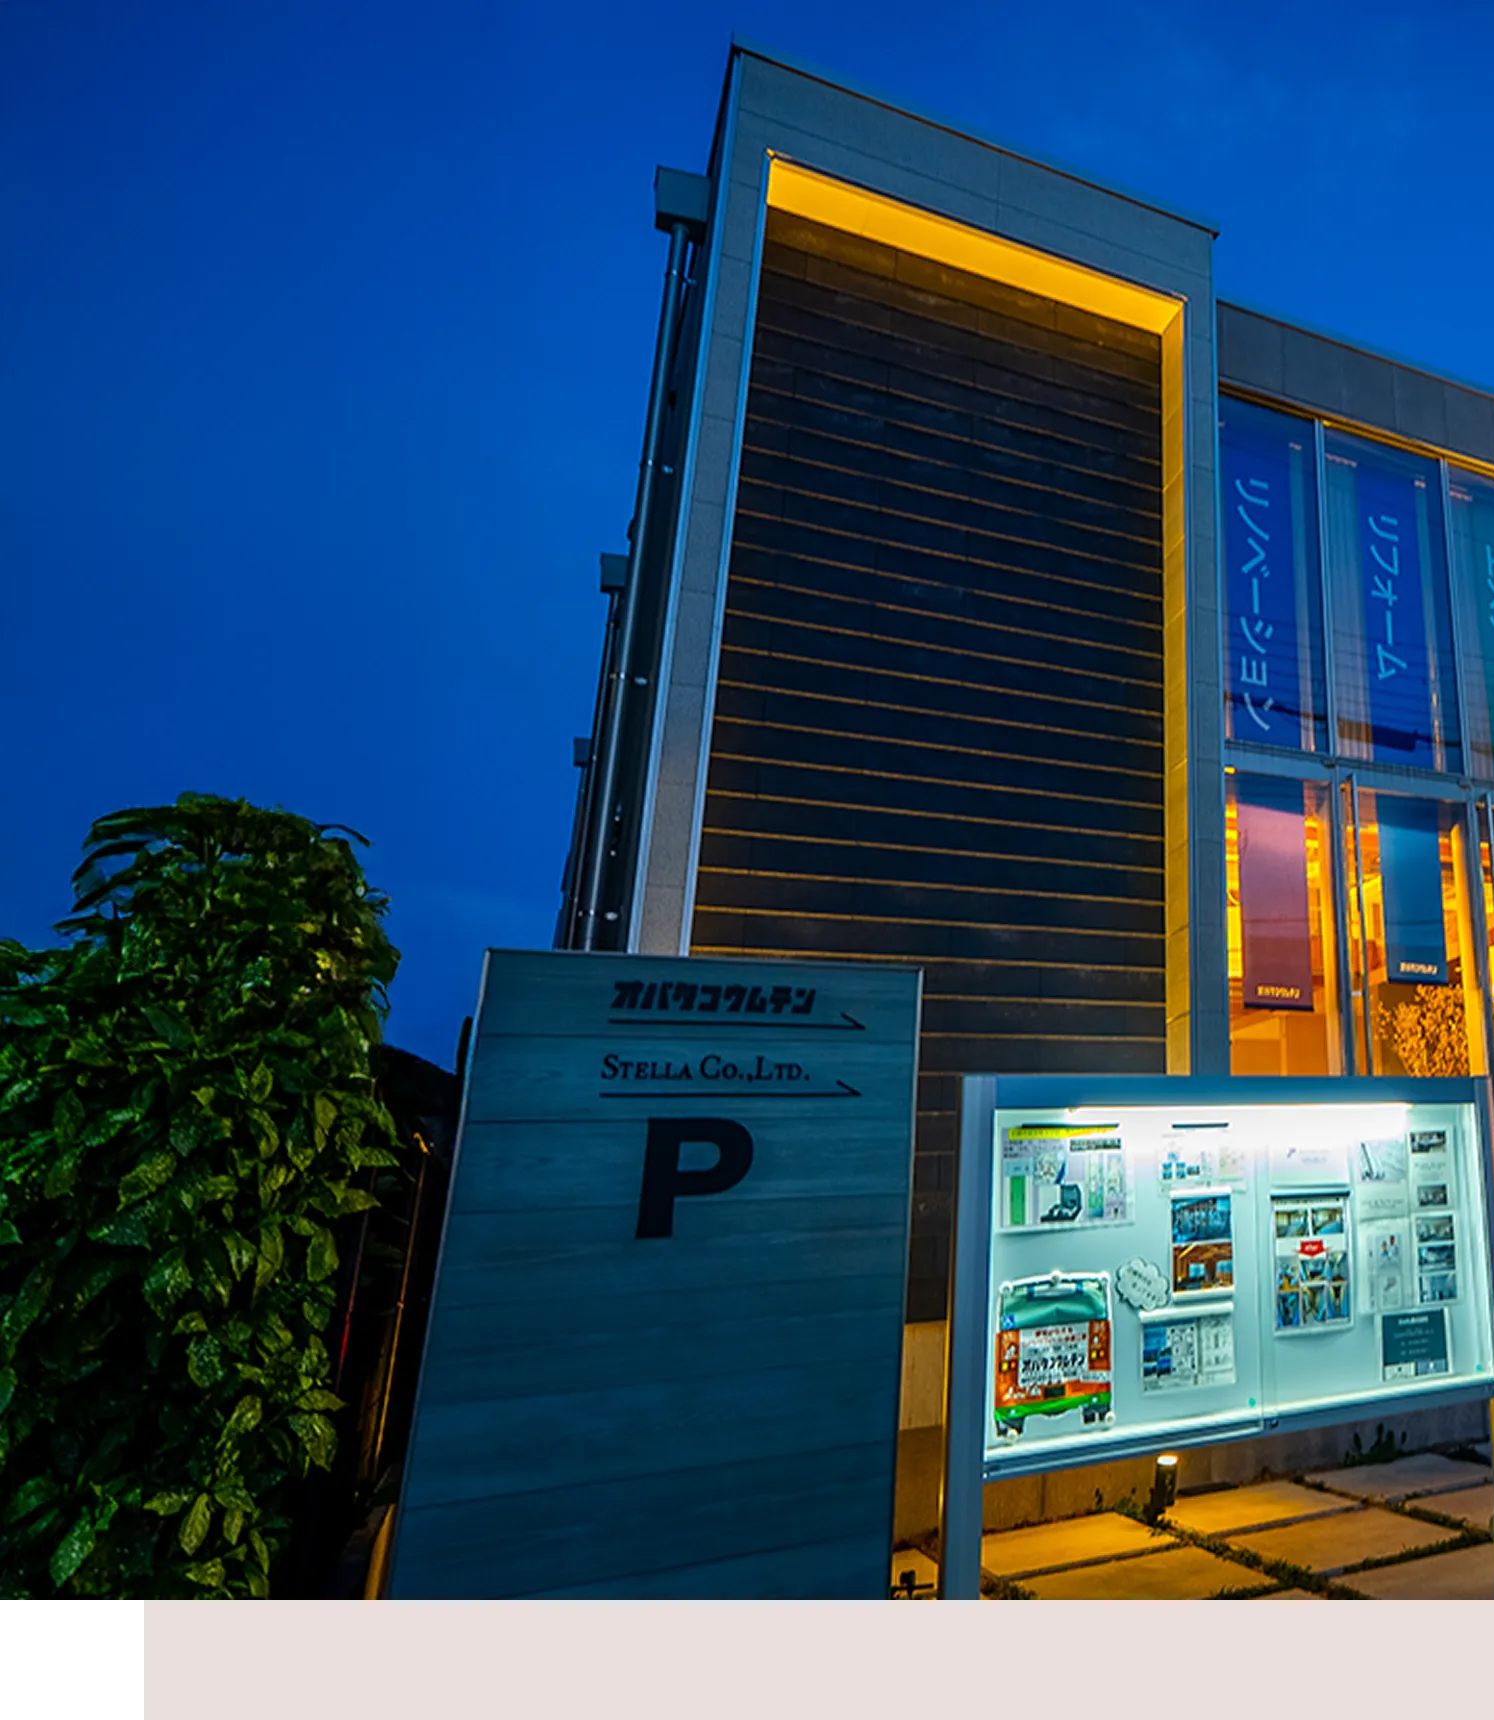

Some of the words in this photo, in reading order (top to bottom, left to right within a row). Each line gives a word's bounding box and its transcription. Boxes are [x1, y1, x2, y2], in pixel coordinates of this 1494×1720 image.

[1234, 477, 1275, 732] リノベーション
[1368, 514, 1408, 681] リフォーム
[634, 1117, 755, 1239] P
